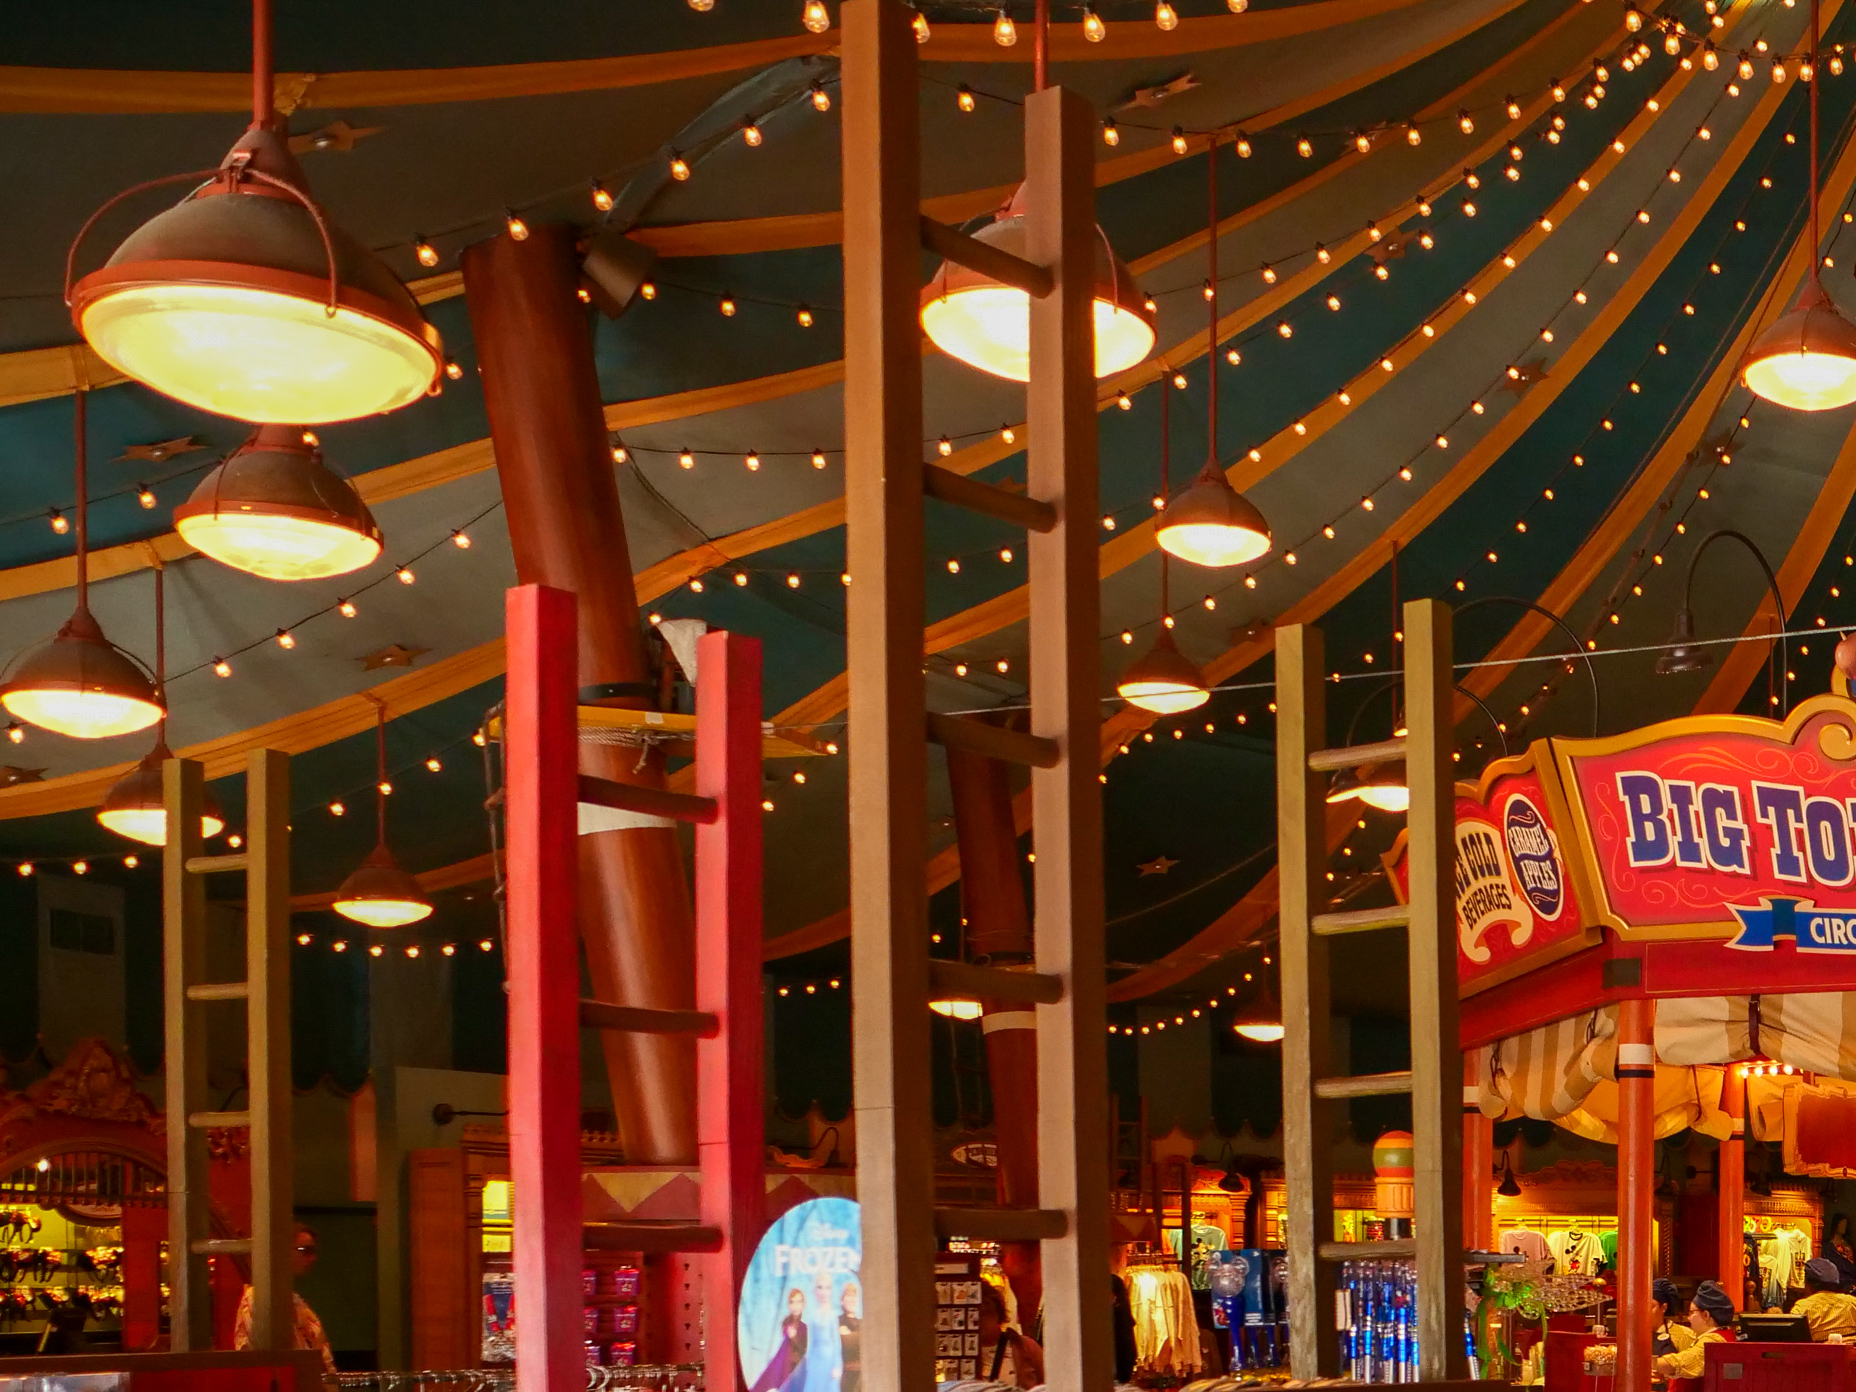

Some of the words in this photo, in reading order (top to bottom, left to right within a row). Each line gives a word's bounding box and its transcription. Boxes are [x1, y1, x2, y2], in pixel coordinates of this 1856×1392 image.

[1507, 822, 1550, 857] CARAMEL
[1616, 769, 1754, 871] BIG
[1461, 831, 1502, 881] COLD
[1520, 859, 1558, 890] APPLES
[1462, 883, 1512, 931] BEVERAGES
